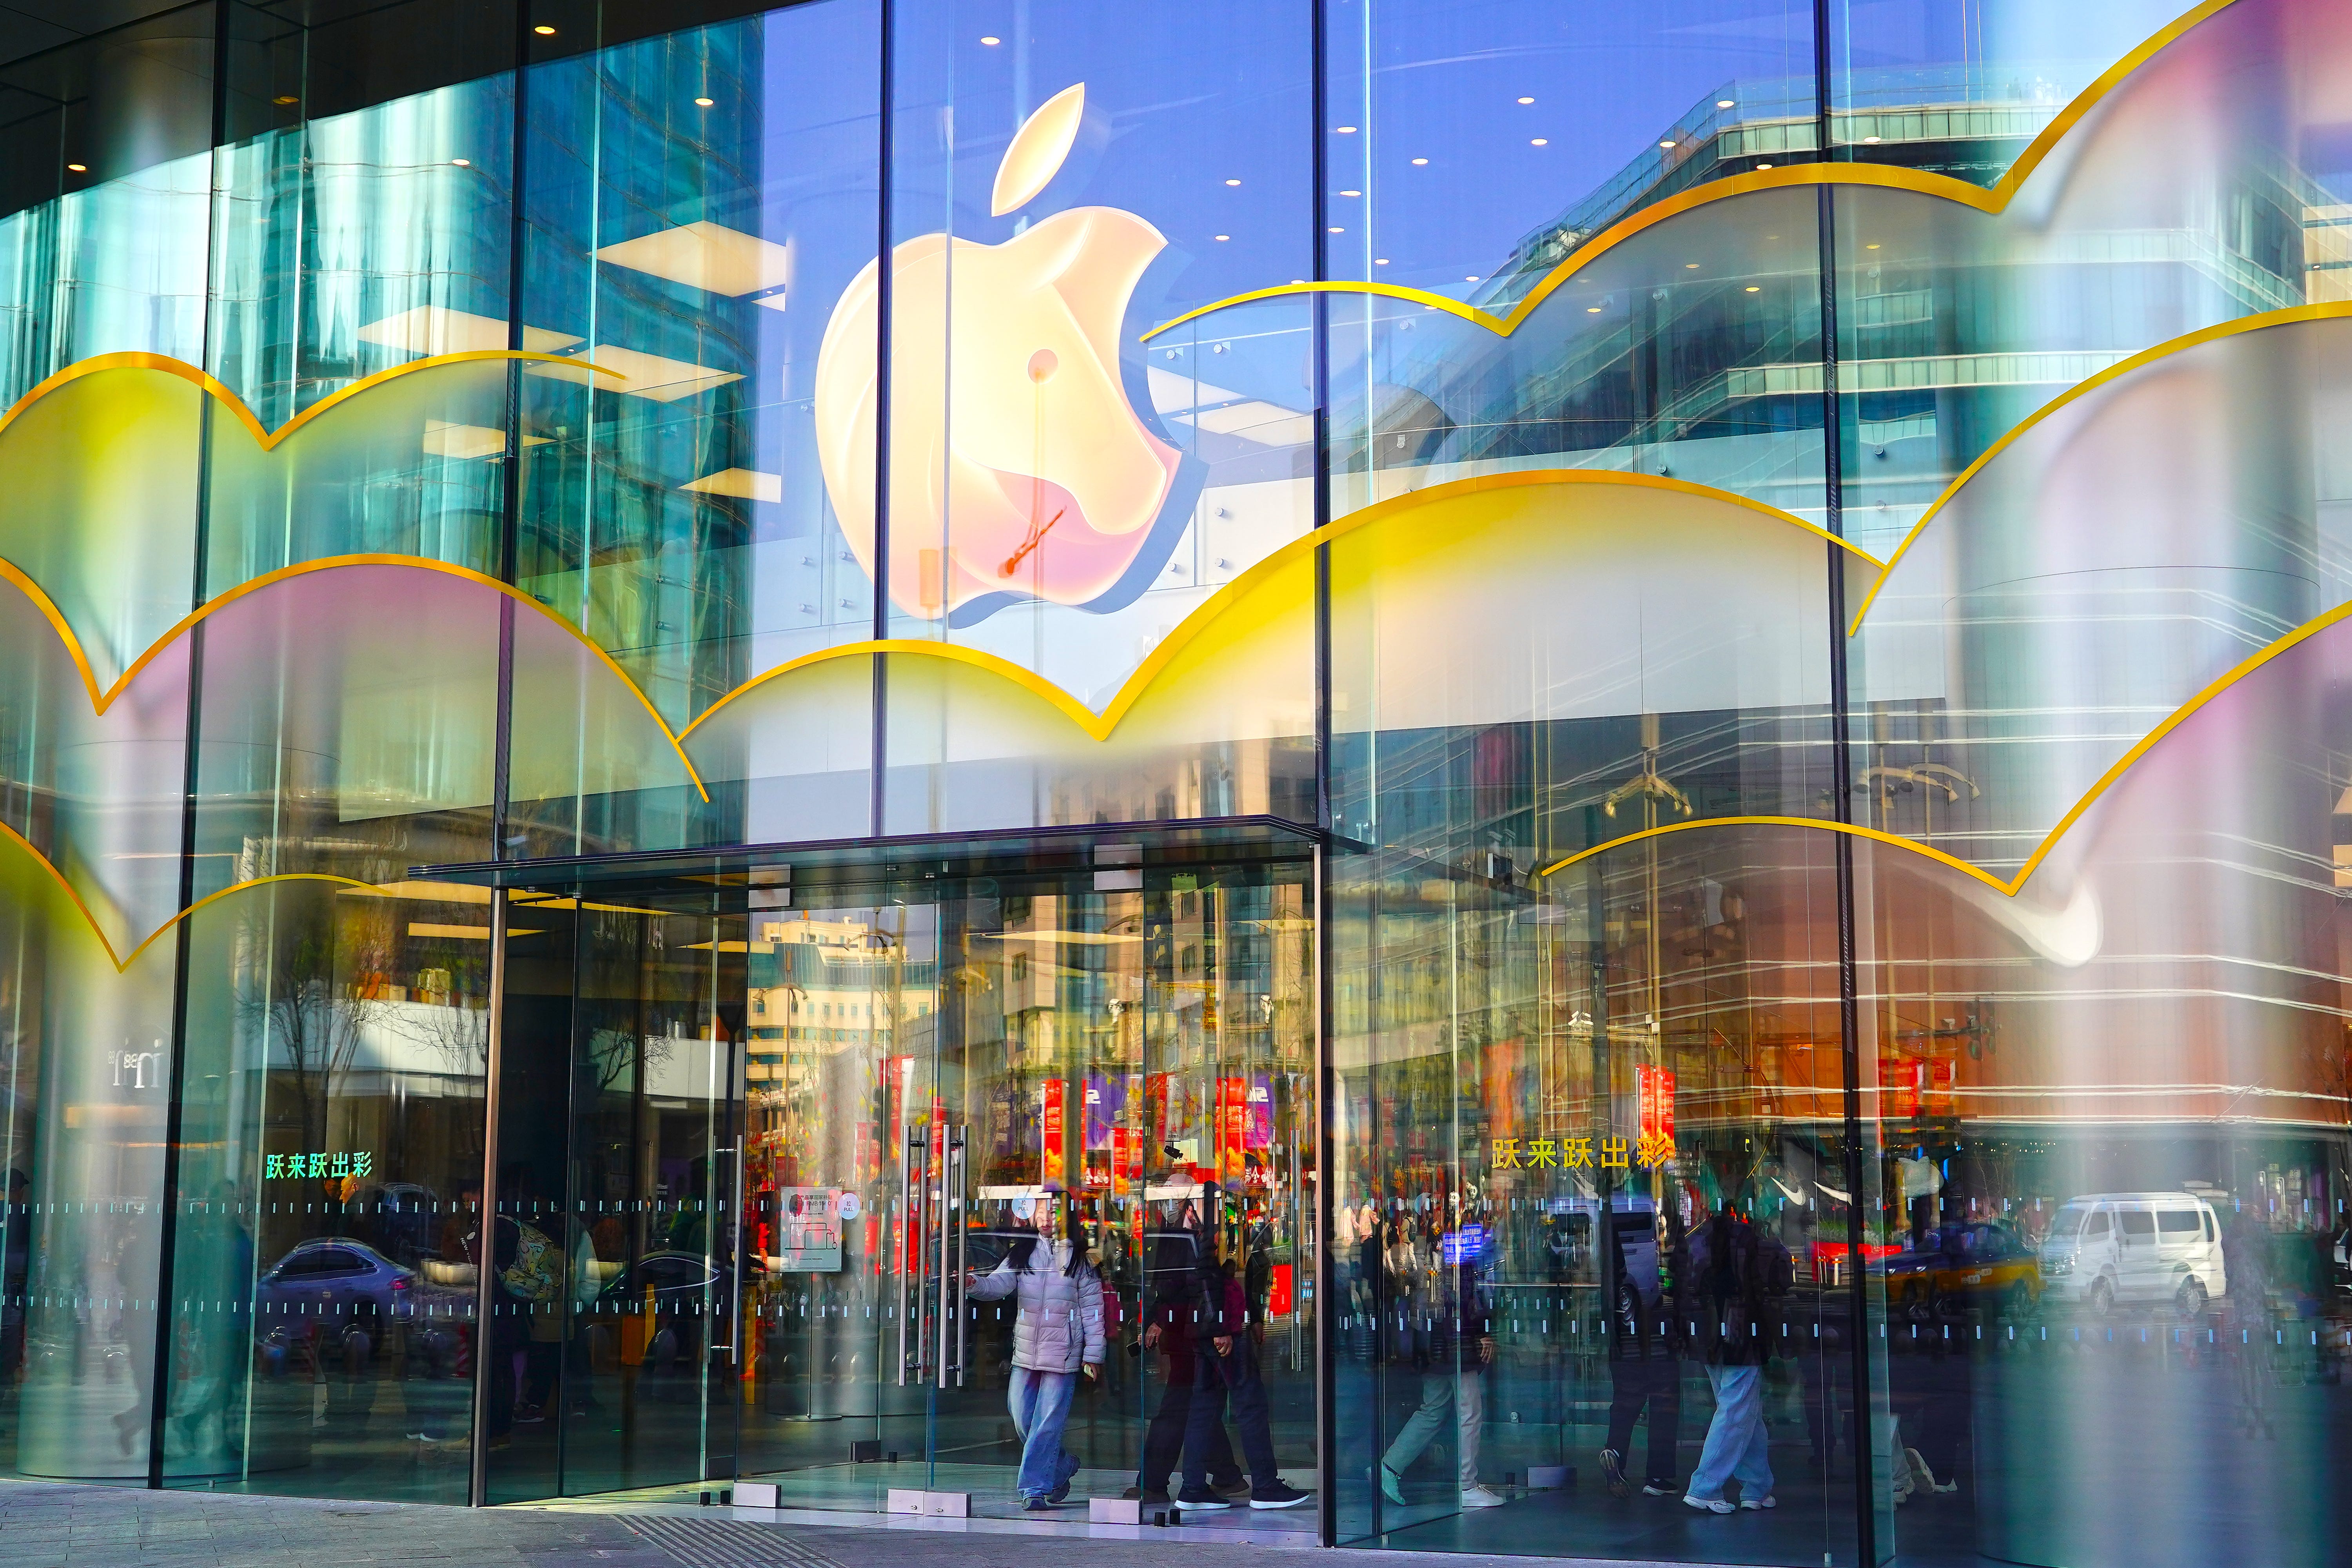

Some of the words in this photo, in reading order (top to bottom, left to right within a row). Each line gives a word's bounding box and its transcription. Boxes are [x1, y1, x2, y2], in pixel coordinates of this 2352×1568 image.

[265, 1151, 372, 1180] 跃来跃出彩
[1491, 1136, 1668, 1169] 跃来跃出彩
[460, 1237, 469, 1251] NEW
